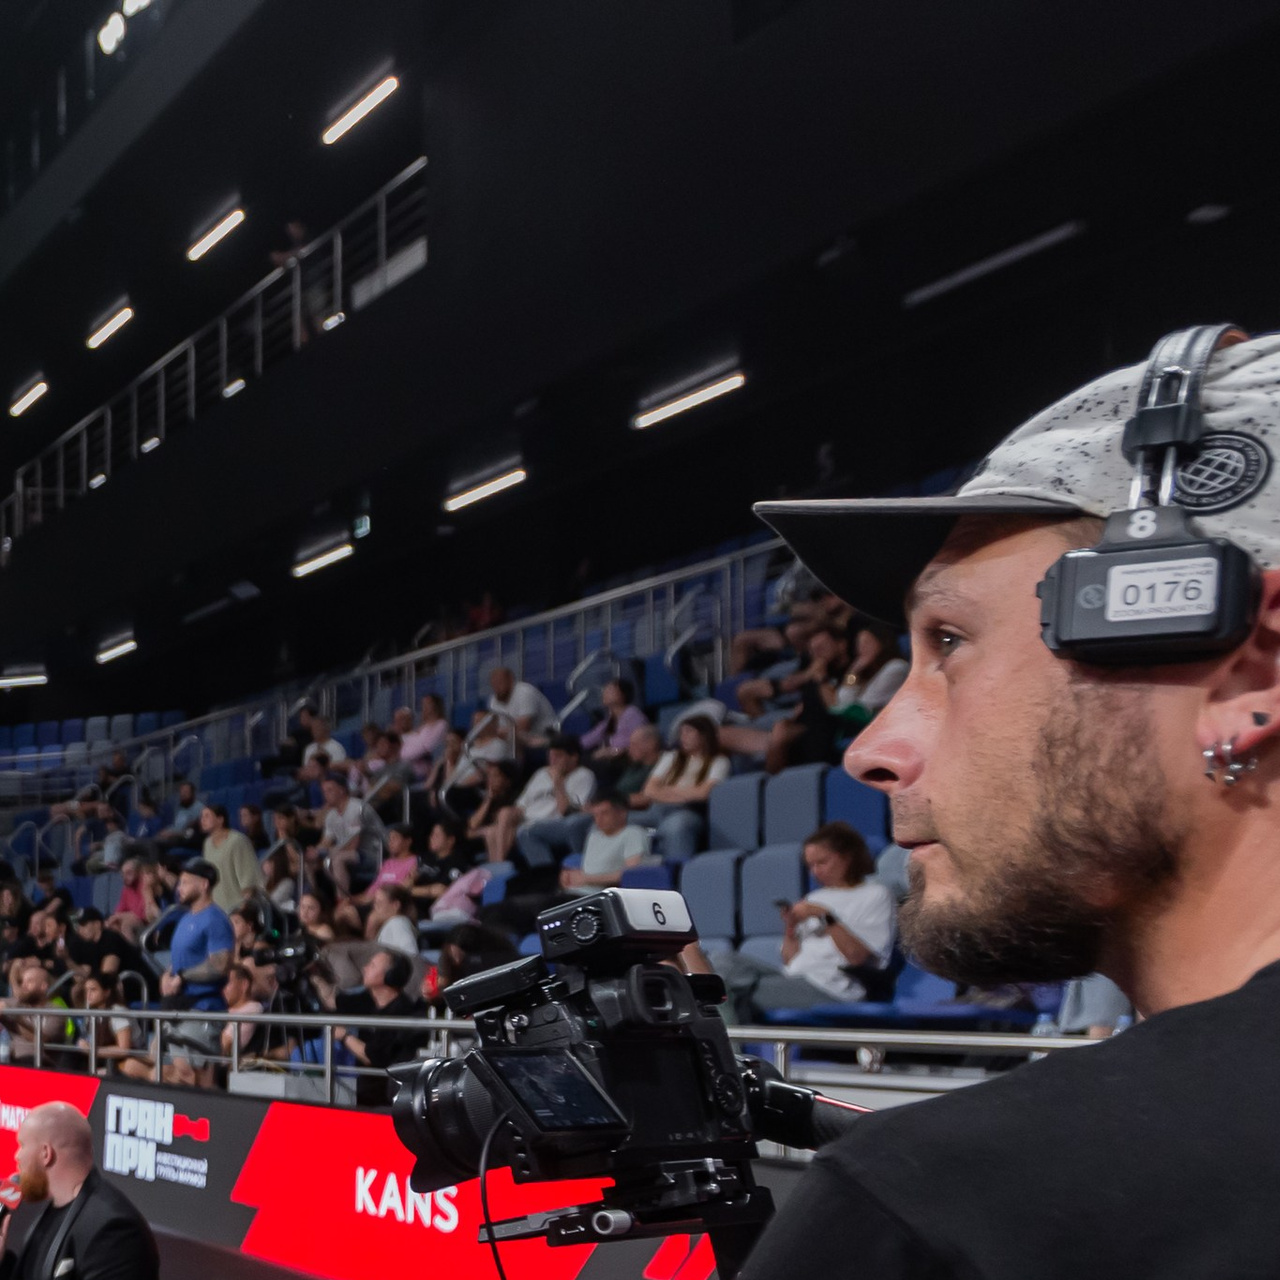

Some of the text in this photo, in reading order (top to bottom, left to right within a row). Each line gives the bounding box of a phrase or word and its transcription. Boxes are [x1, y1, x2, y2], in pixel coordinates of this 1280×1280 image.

[1126, 509, 1157, 538] 8
[1122, 579, 1203, 606] 0176
[652, 902, 667, 926] 6
[105, 1094, 174, 1146] ГРАН
[103, 1132, 157, 1182] ПРИ
[355, 1166, 459, 1234] KANS
